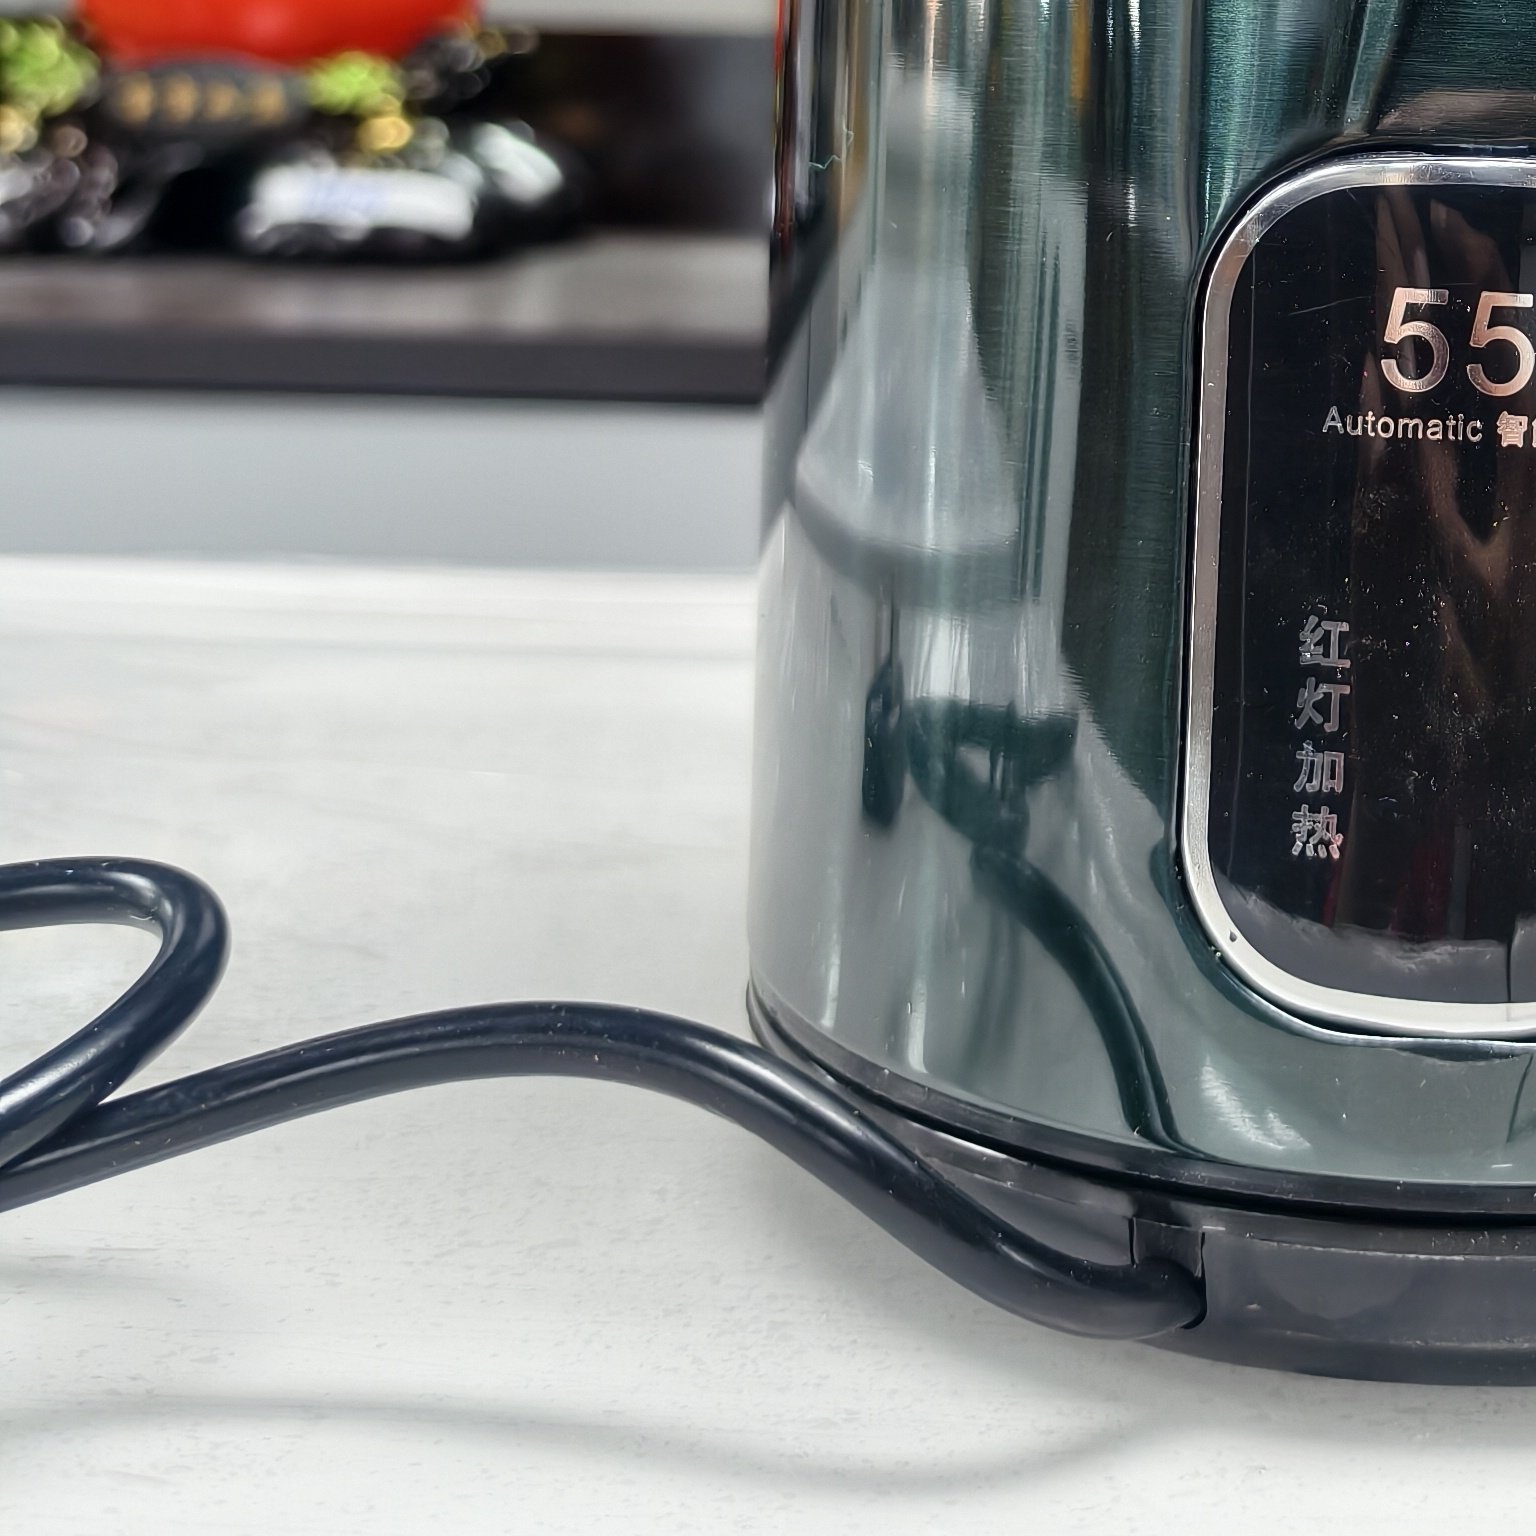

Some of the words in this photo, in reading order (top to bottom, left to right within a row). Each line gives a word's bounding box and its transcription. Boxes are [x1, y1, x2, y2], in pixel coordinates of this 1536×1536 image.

[1322, 405, 1484, 441] Automatic
[1291, 616, 1350, 860] 红灯加热
